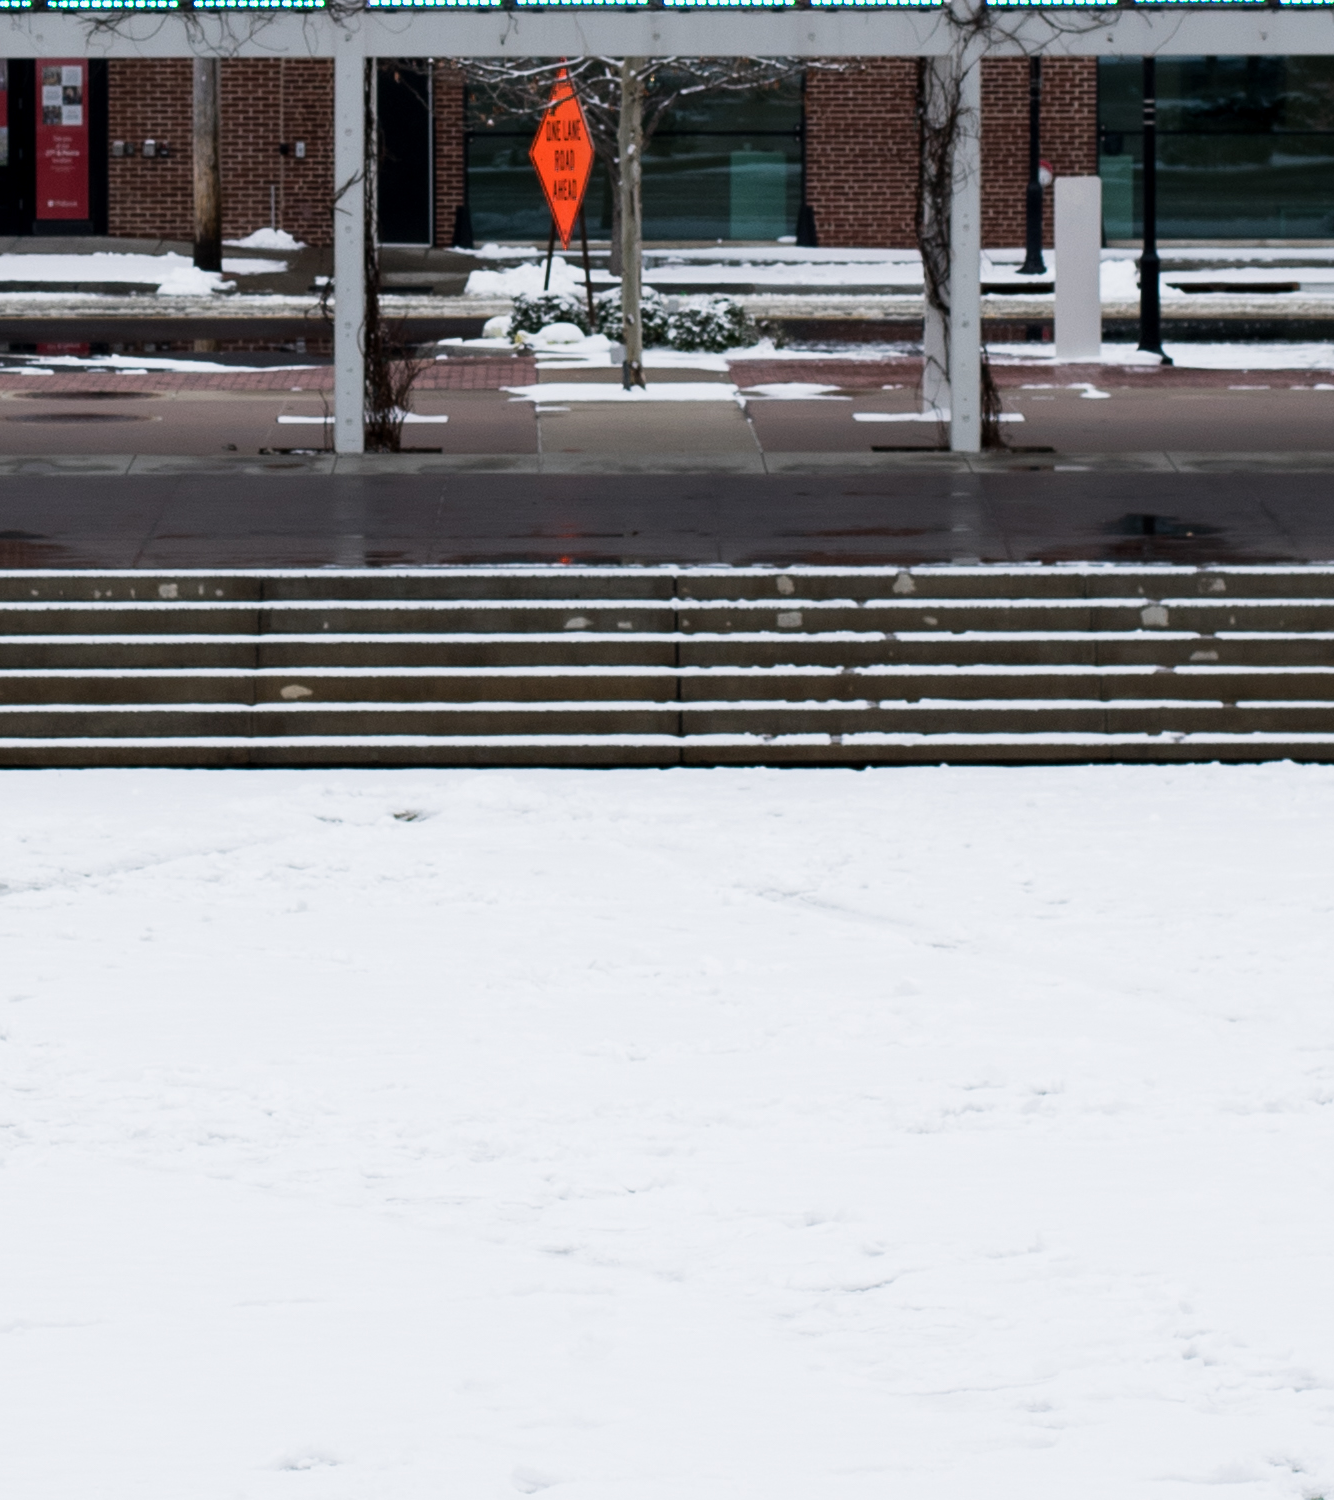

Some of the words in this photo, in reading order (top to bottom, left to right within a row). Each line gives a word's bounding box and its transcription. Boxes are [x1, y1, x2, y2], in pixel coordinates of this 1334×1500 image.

[546, 120, 561, 141] ONE
[563, 120, 581, 141] LANE
[554, 150, 575, 171] ROAD
[553, 179, 577, 201] AHEAD
